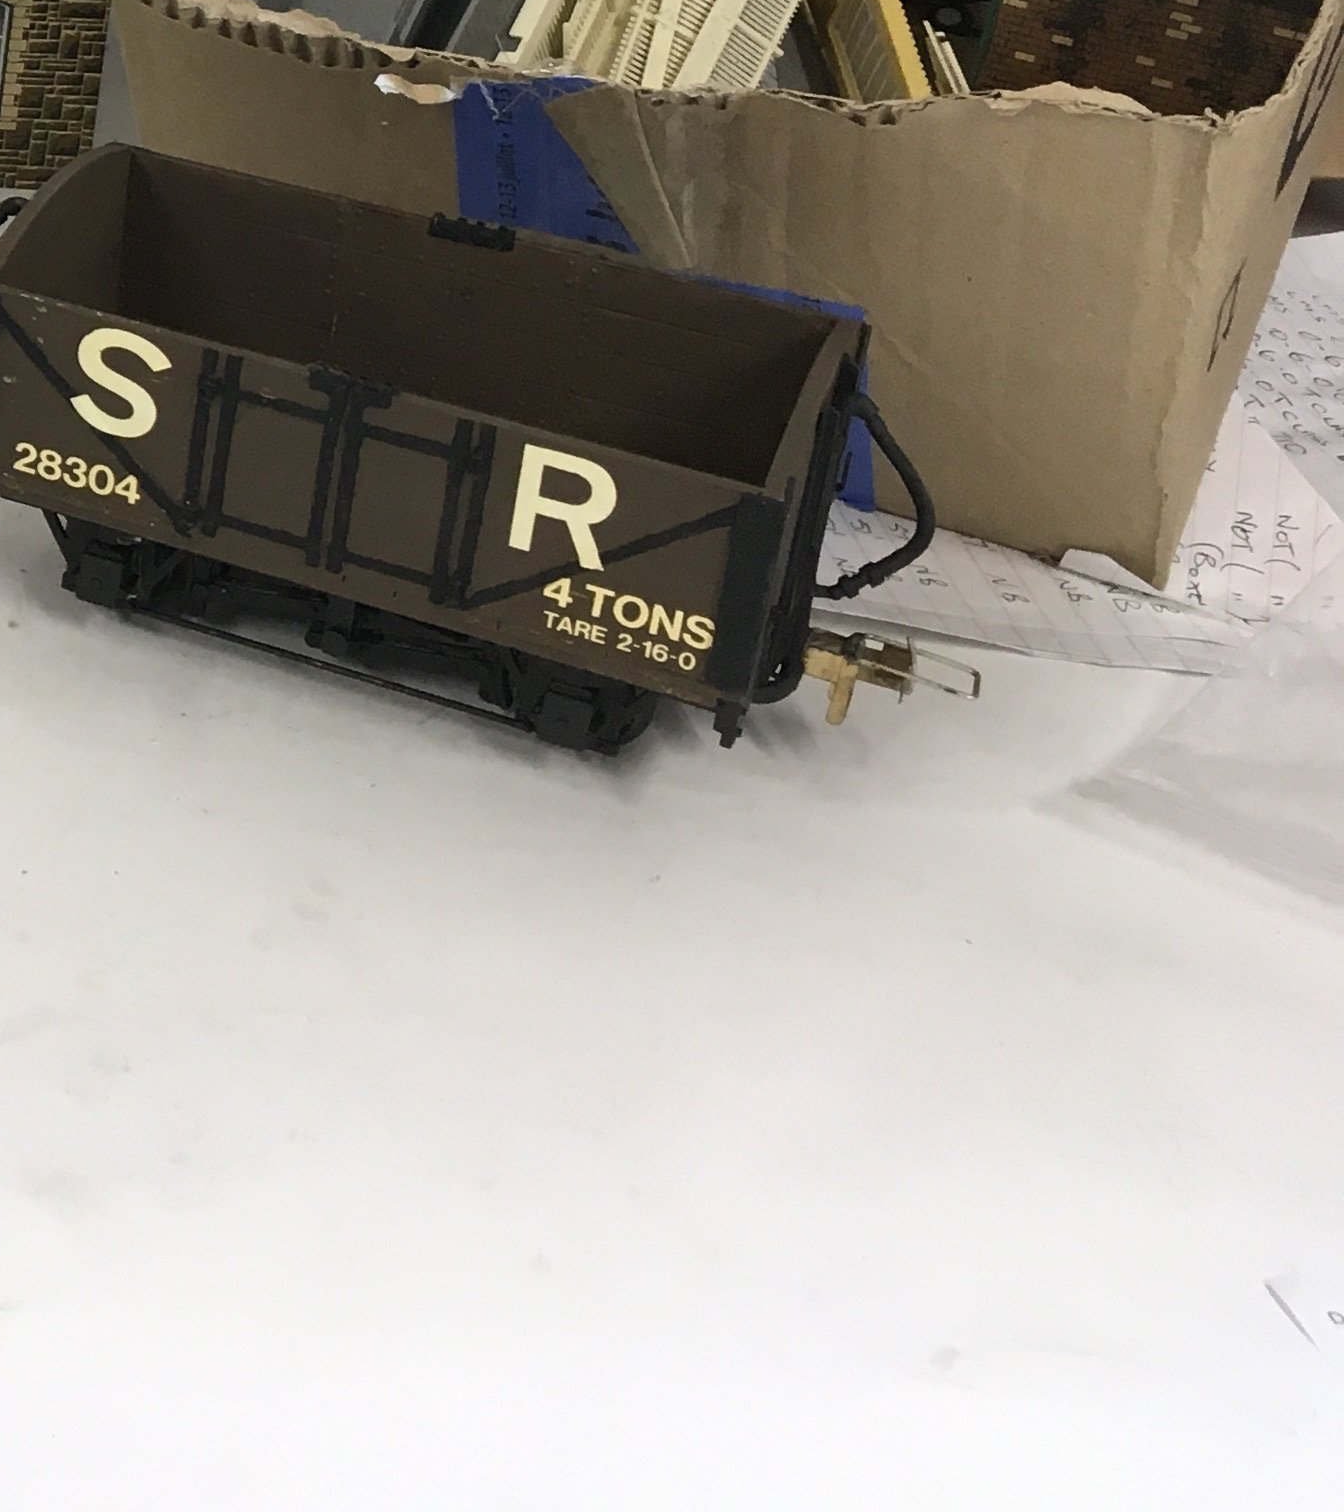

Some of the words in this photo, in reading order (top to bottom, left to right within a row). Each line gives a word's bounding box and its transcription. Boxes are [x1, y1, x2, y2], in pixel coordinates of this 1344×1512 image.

[12, 441, 142, 506] 28304
[69, 327, 173, 438] S
[508, 443, 618, 572] R
[542, 577, 574, 609] 4
[585, 583, 717, 650] TONS
[543, 610, 609, 646] TARE
[616, 633, 697, 671] 2-16-0
